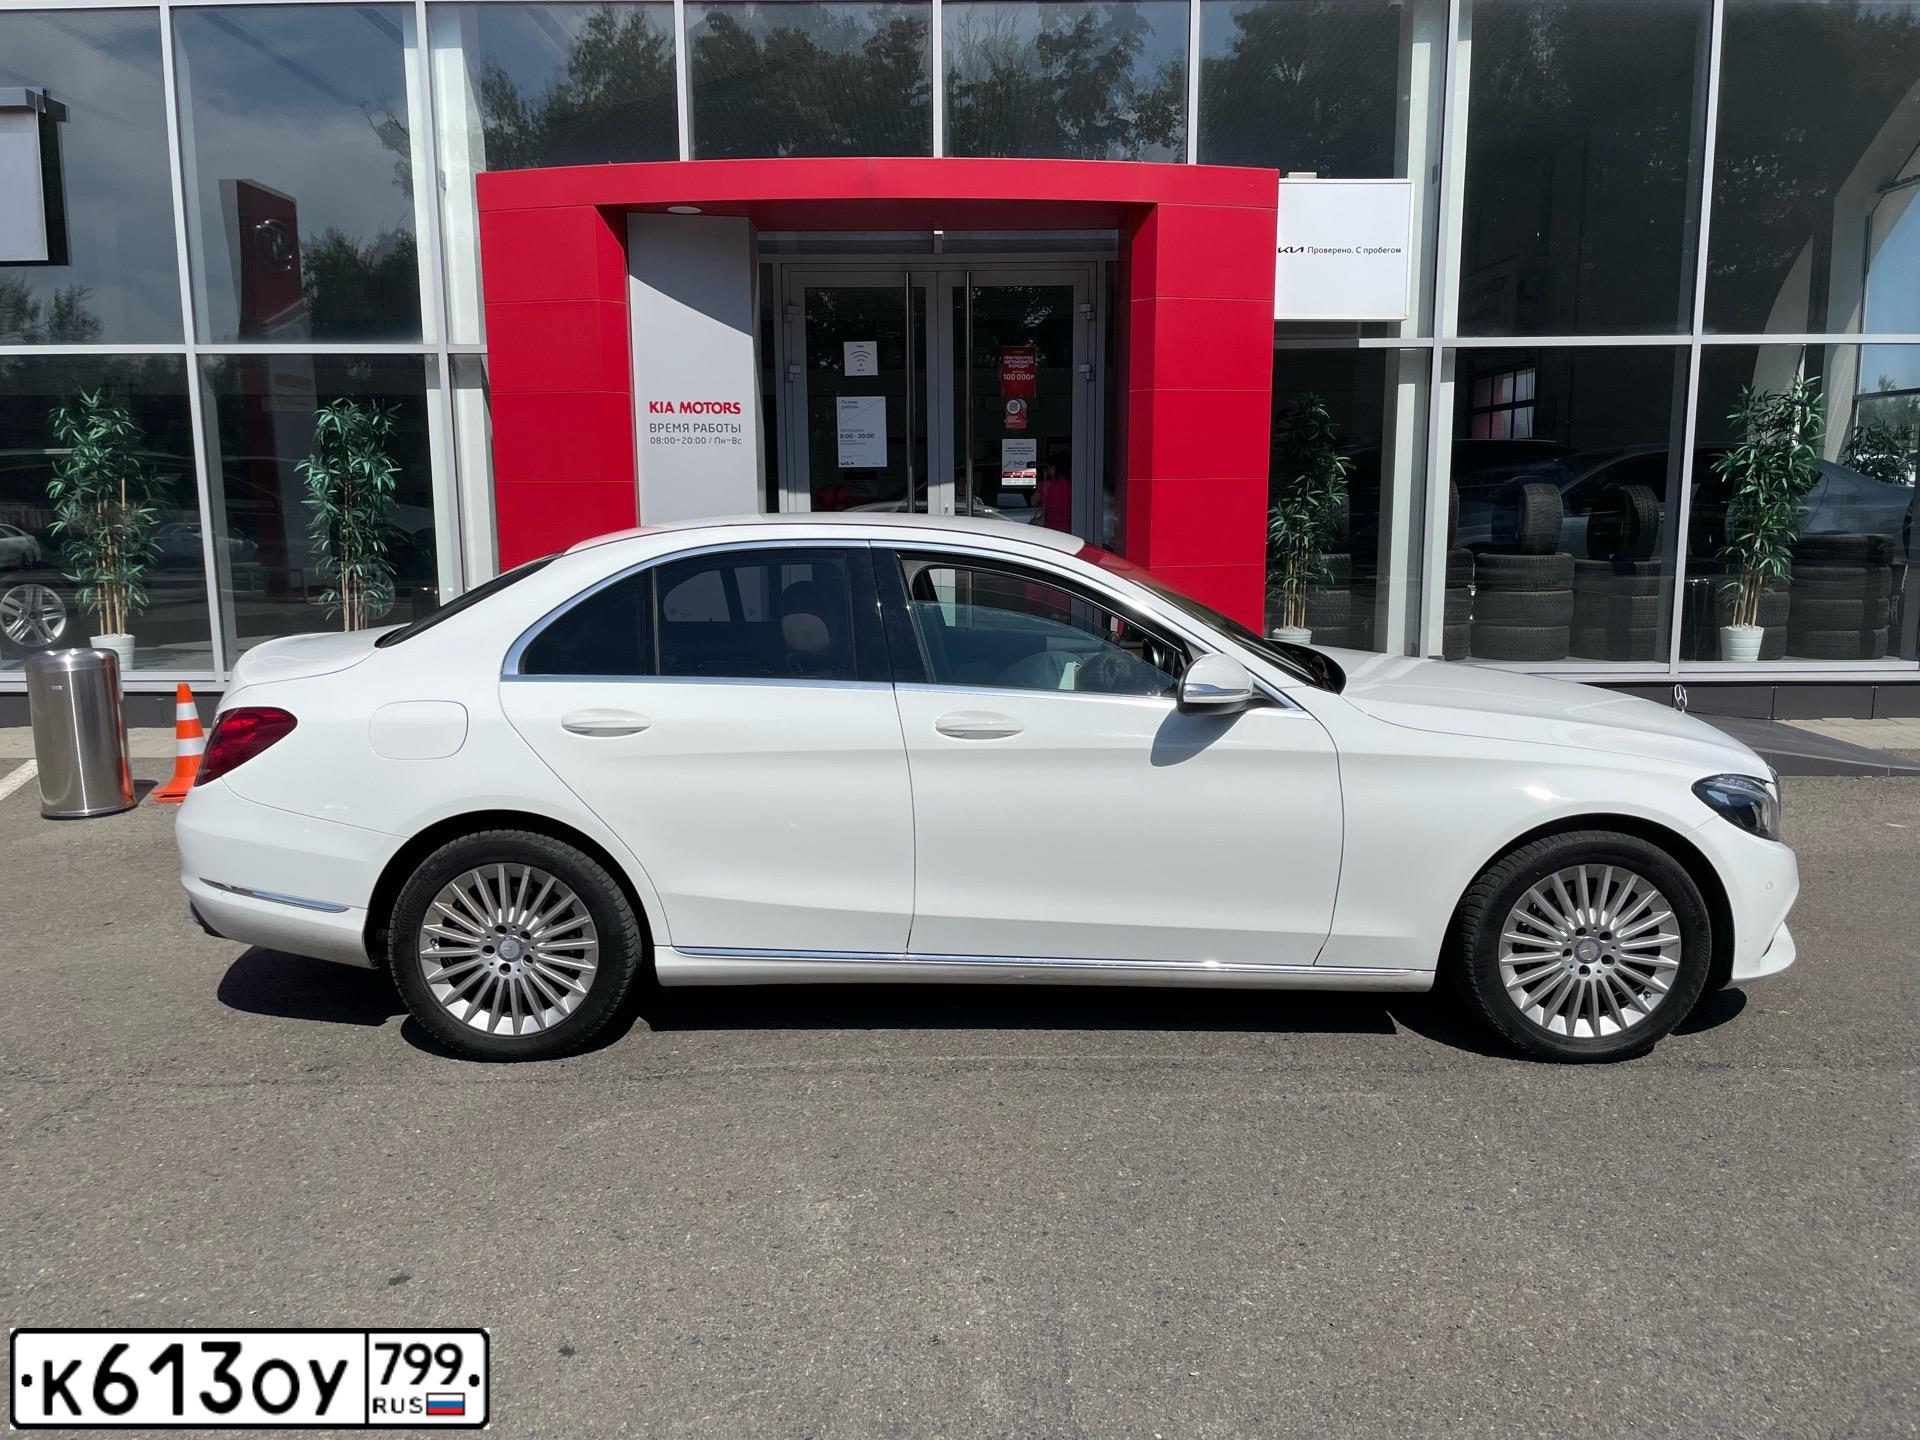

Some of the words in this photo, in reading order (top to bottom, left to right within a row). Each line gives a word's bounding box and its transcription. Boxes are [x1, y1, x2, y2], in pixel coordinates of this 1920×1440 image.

[1307, 246, 1354, 255] Проверено.
[1355, 246, 1362, 254] С
[1363, 246, 1402, 255] пробегом
[649, 401, 675, 414] KIA
[679, 401, 741, 415] MOTORS
[649, 423, 690, 434] ВРЕМЯ
[693, 423, 742, 434] РАБОТЫ
